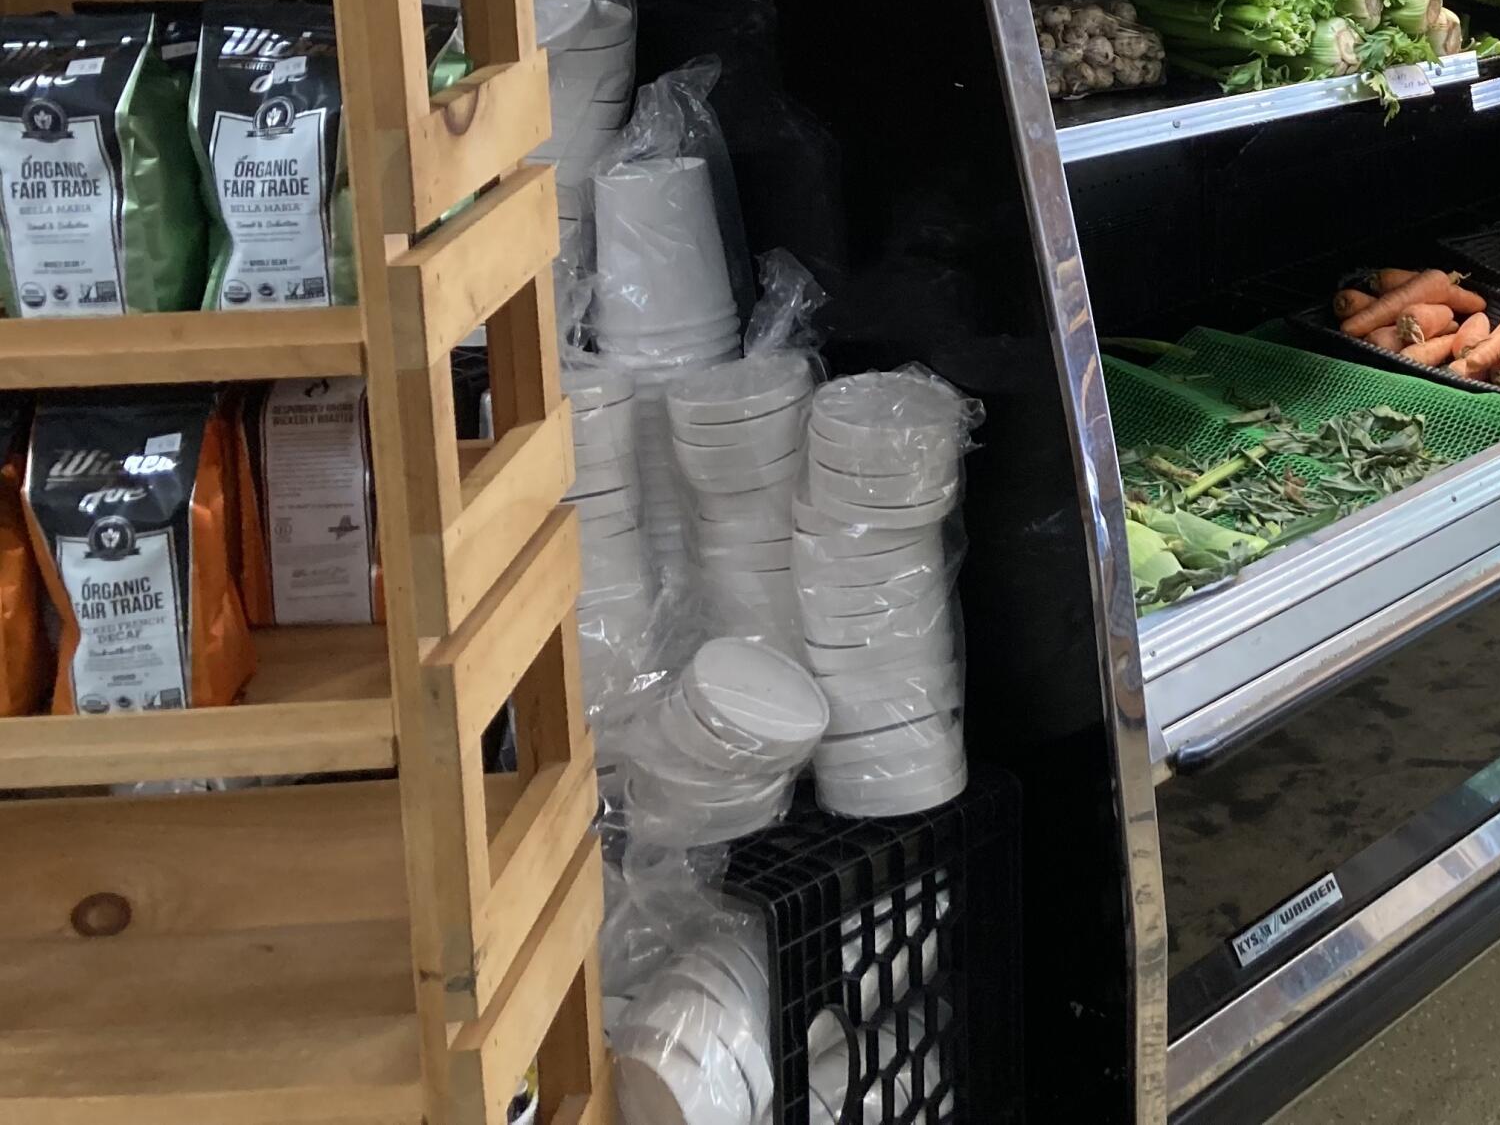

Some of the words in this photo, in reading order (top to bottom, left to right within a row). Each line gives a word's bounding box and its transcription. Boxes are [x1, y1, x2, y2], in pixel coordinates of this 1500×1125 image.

[21, 159, 88, 180] ORGANIC
[234, 159, 298, 178] ORGANIC
[10, 181, 47, 200] FAIR
[51, 178, 102, 199] TRADE
[223, 179, 255, 198] FAIR
[260, 177, 310, 198] TRADE
[81, 577, 151, 601] ORGANIC
[110, 592, 164, 616] TRADE
